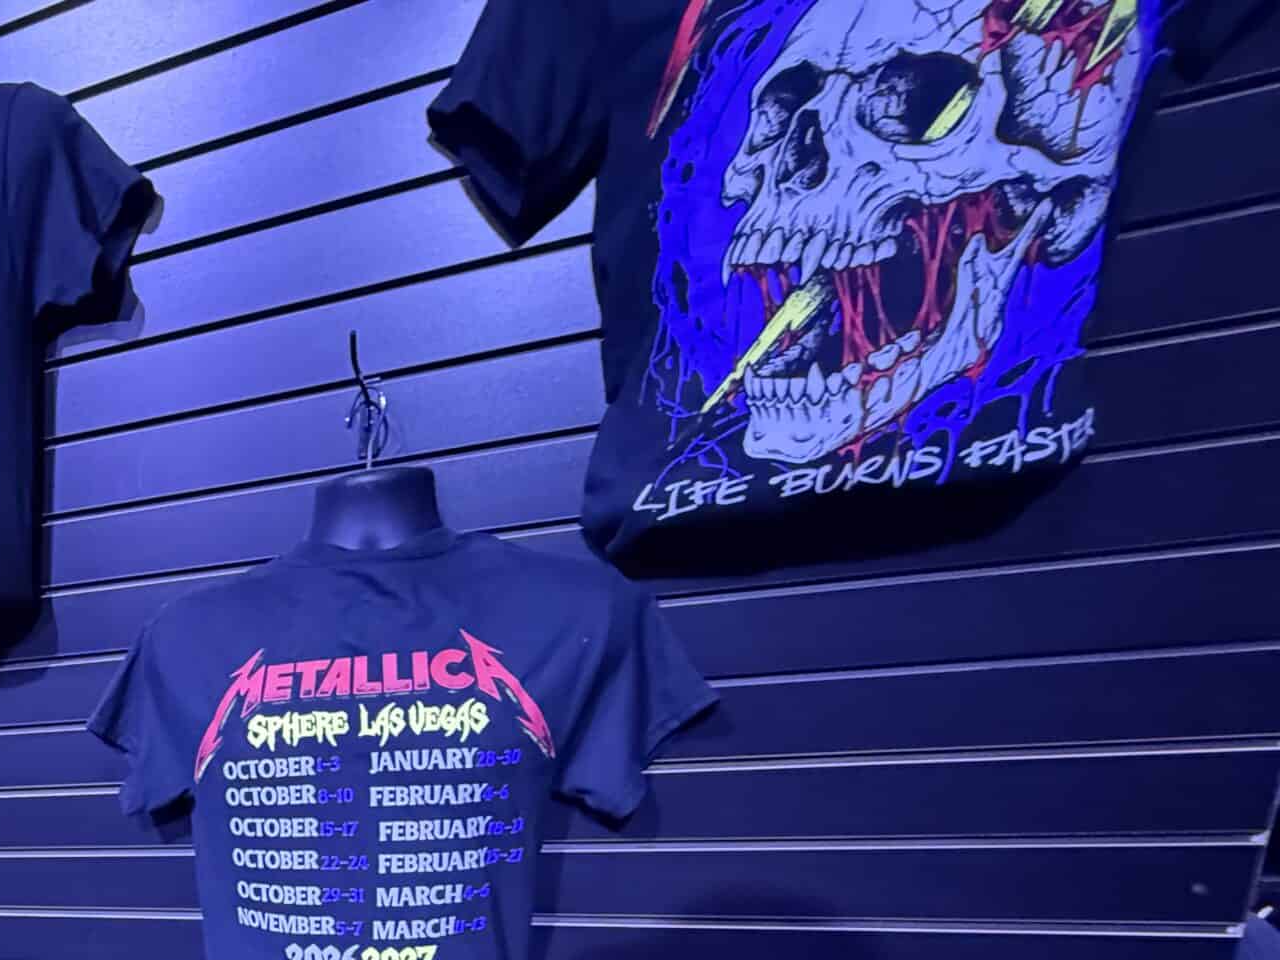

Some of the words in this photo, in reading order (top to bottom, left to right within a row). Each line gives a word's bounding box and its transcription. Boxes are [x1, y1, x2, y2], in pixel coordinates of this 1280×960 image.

[632, 473, 755, 521] LIFE
[768, 445, 945, 499] BURNS
[194, 628, 557, 784] METALLICA
[247, 710, 351, 752] SPHERE
[358, 701, 406, 748] LAS
[406, 697, 491, 744] VEGAS
[223, 756, 317, 781] OCTOBER
[316, 755, 343, 773] 1-3
[369, 747, 479, 775] JANUARY
[225, 784, 317, 807] OCTOBER
[317, 788, 355, 804] 8-10
[369, 783, 489, 808] FEBRUARY
[229, 816, 319, 838] OCTOBER
[319, 820, 360, 837] 15-17
[378, 815, 493, 842] FEBRUARY
[232, 847, 319, 871] OCTOBER
[319, 854, 370, 872] 22-24
[378, 846, 489, 875] FEBRUARY
[236, 880, 322, 907] OCTOBER
[321, 888, 366, 904] 29-31
[375, 883, 465, 909] MARCH
[237, 906, 337, 937] NOVEMBER
[336, 920, 365, 938] 5-7
[372, 915, 457, 942] MARCH
